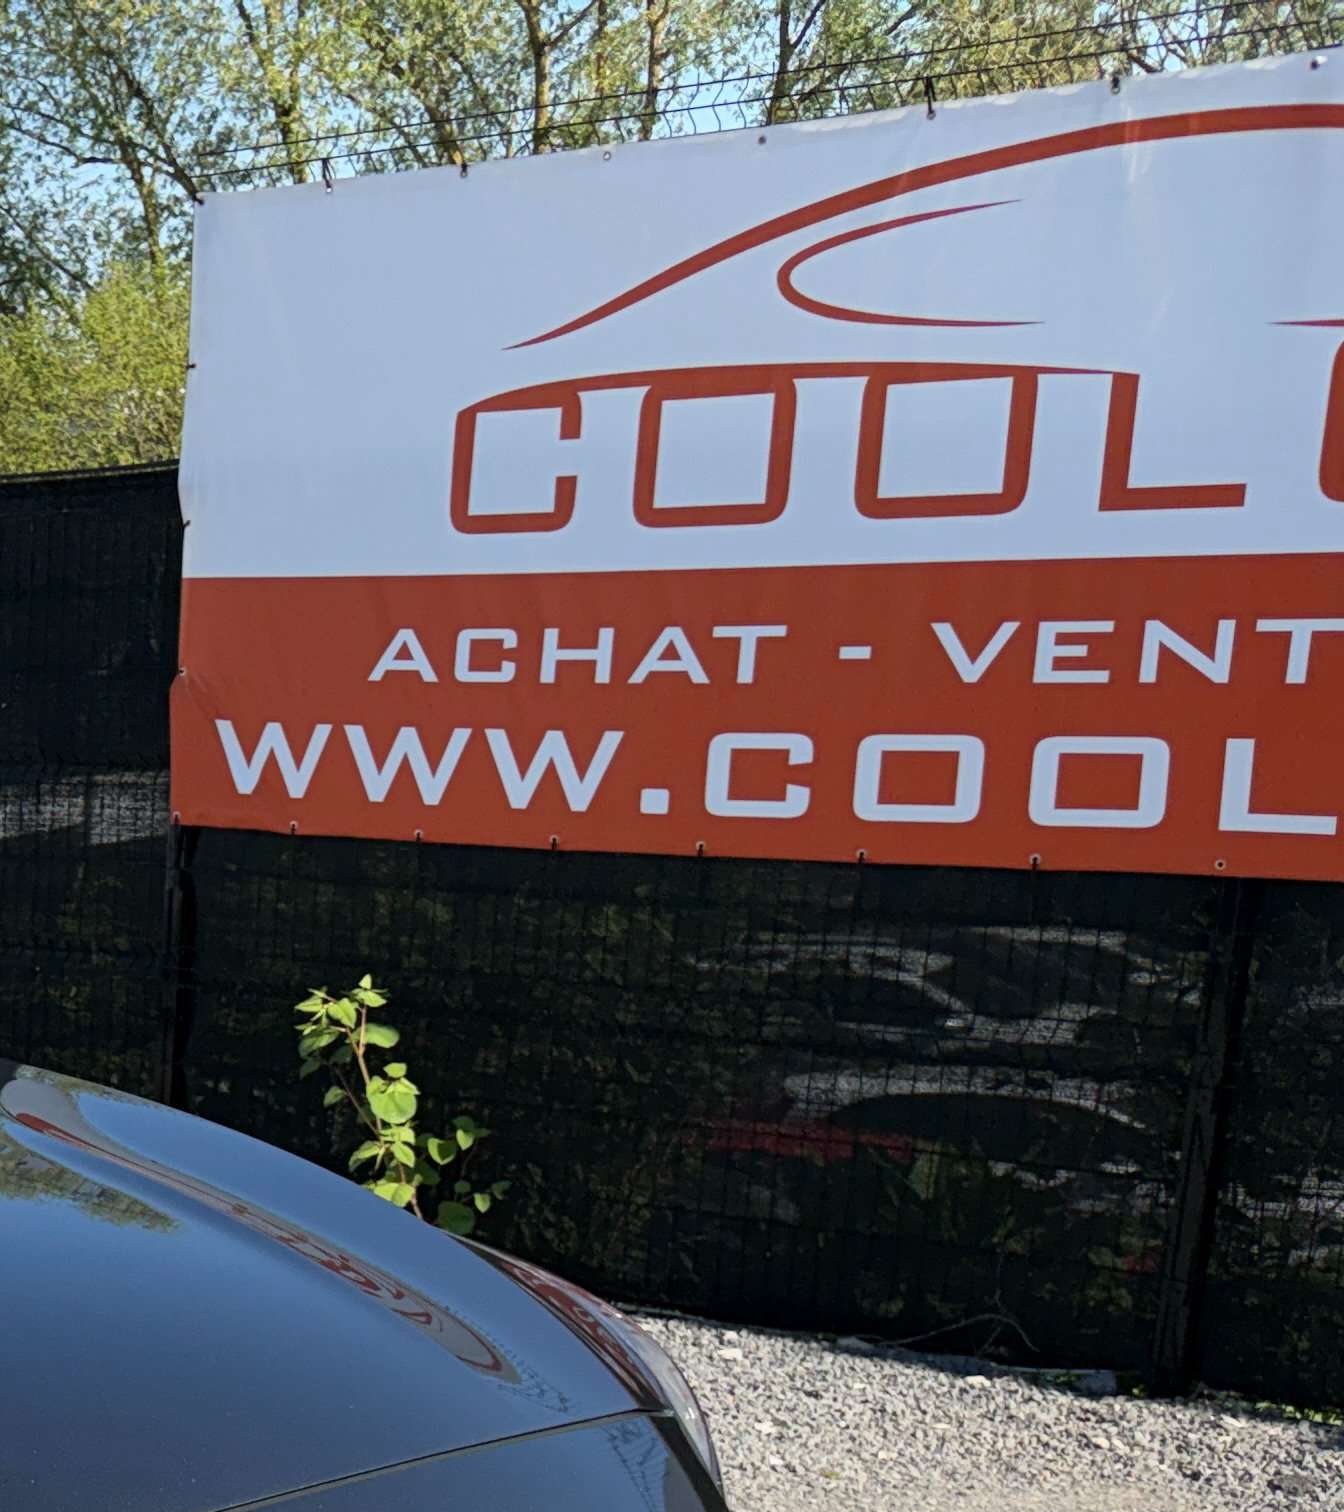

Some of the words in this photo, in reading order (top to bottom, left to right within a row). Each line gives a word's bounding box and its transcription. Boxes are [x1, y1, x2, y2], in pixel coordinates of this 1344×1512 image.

[450, 361, 1247, 535] COOL
[367, 624, 788, 684] ACHAT
[214, 719, 1338, 836] WWW.COOL
